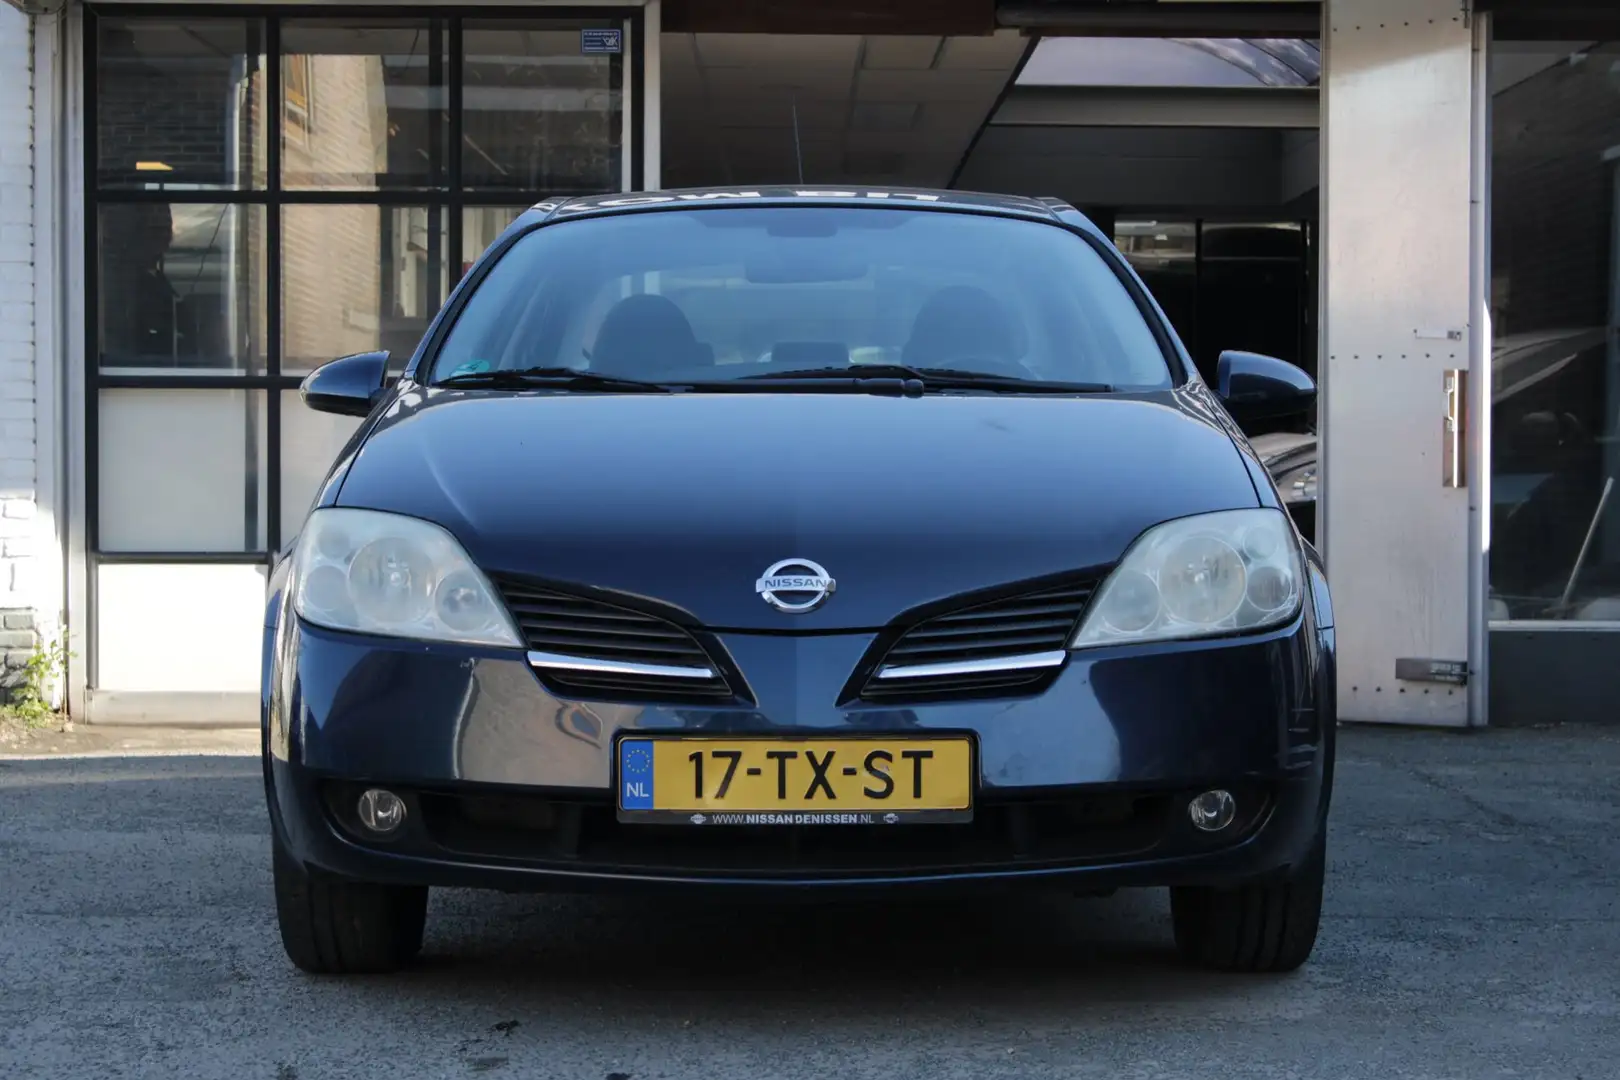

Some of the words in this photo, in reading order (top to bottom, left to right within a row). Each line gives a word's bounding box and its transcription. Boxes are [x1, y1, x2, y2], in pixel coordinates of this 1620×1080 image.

[765, 578, 826, 588] NISSAN
[688, 750, 934, 800] 17-TX-ST
[626, 782, 649, 798] NL
